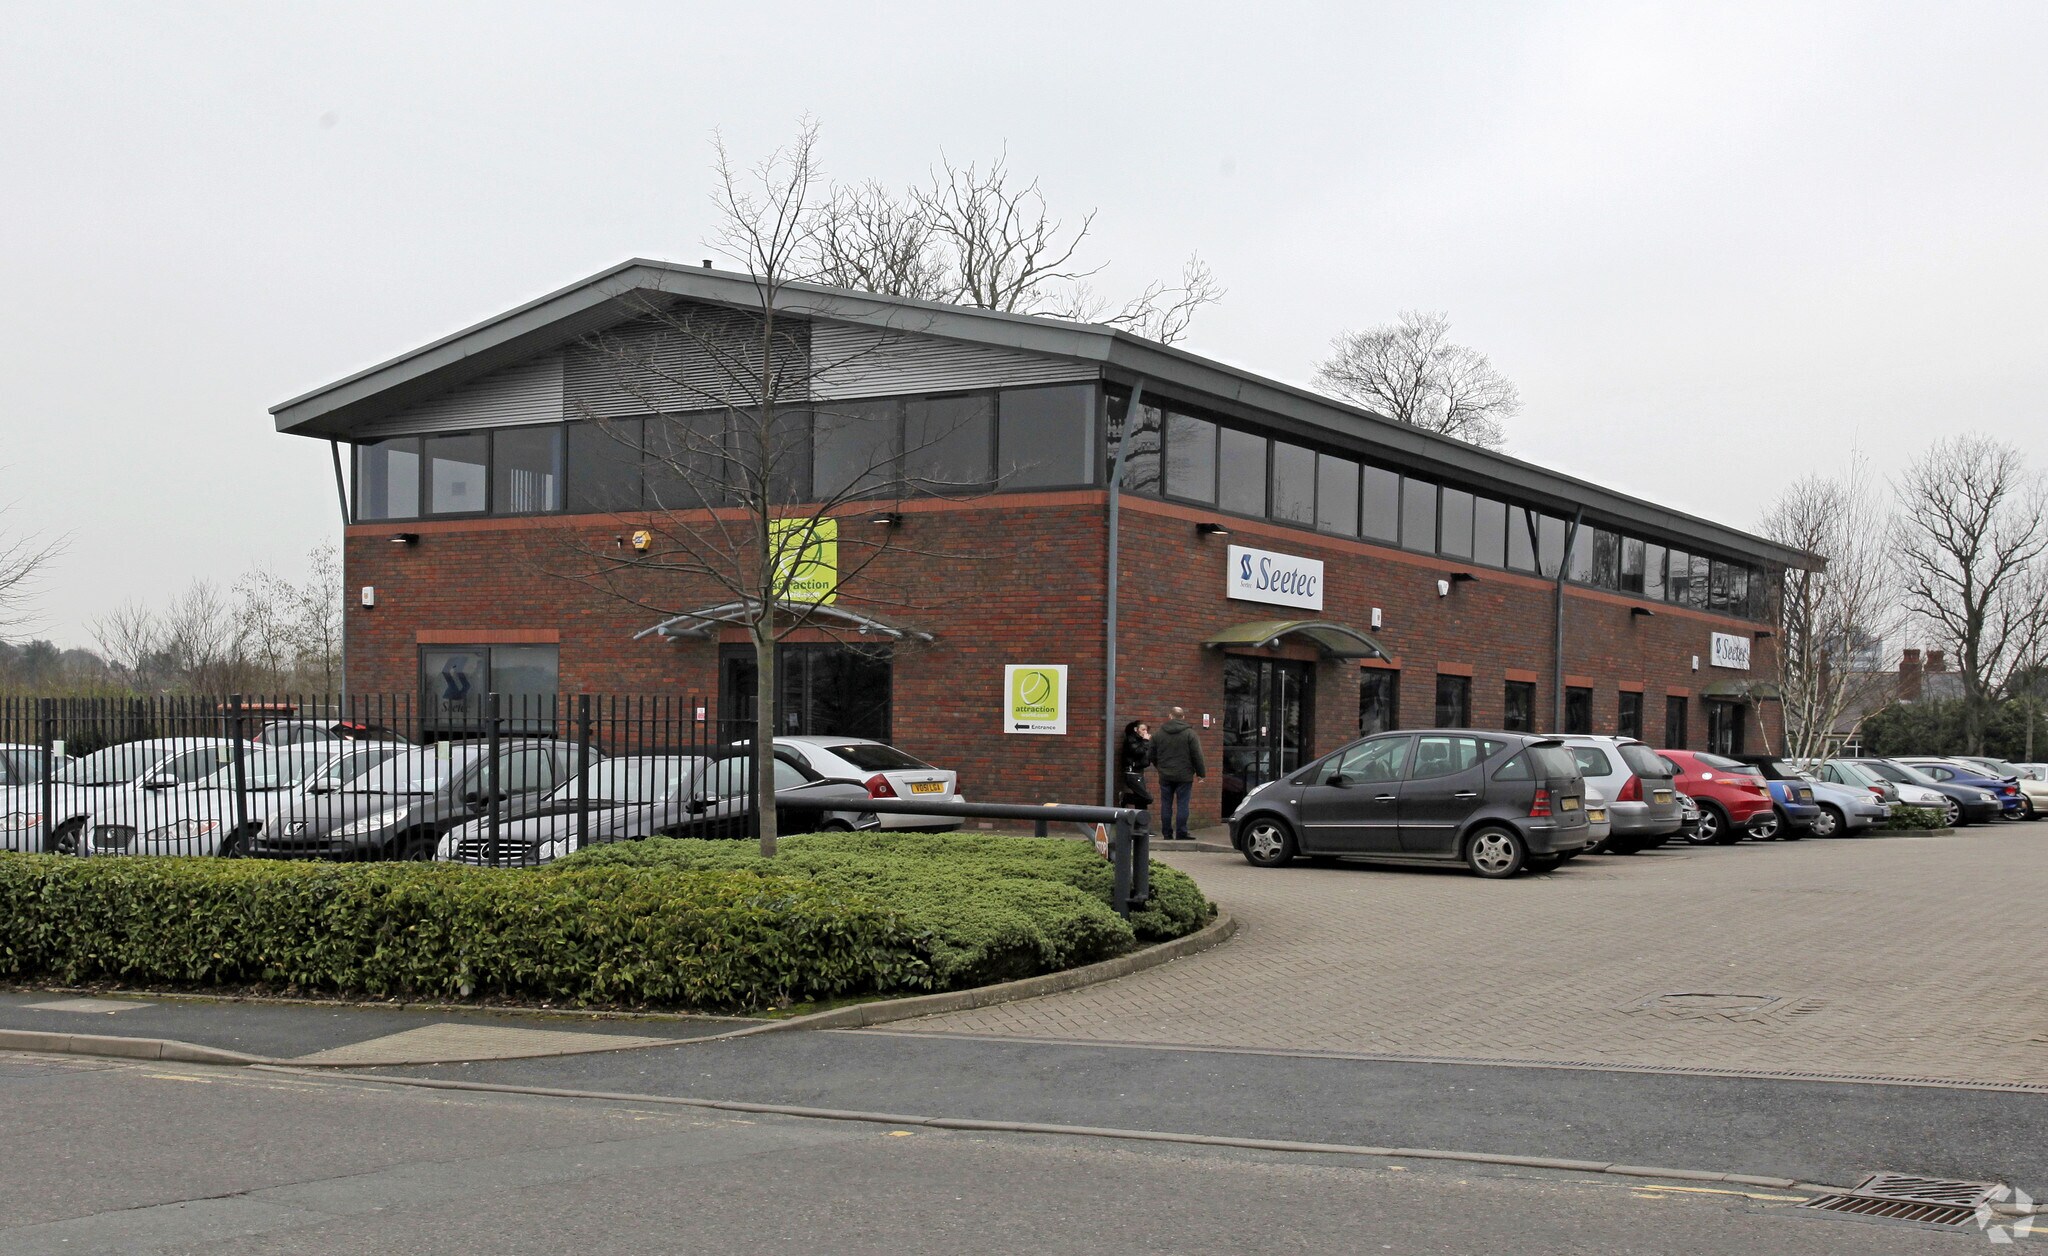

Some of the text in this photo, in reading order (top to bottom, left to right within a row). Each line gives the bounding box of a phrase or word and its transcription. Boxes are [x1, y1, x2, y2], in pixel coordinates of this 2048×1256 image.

[1256, 557, 1317, 597] Seetec
[772, 579, 829, 590] atraction
[1016, 705, 1055, 713] attraction
